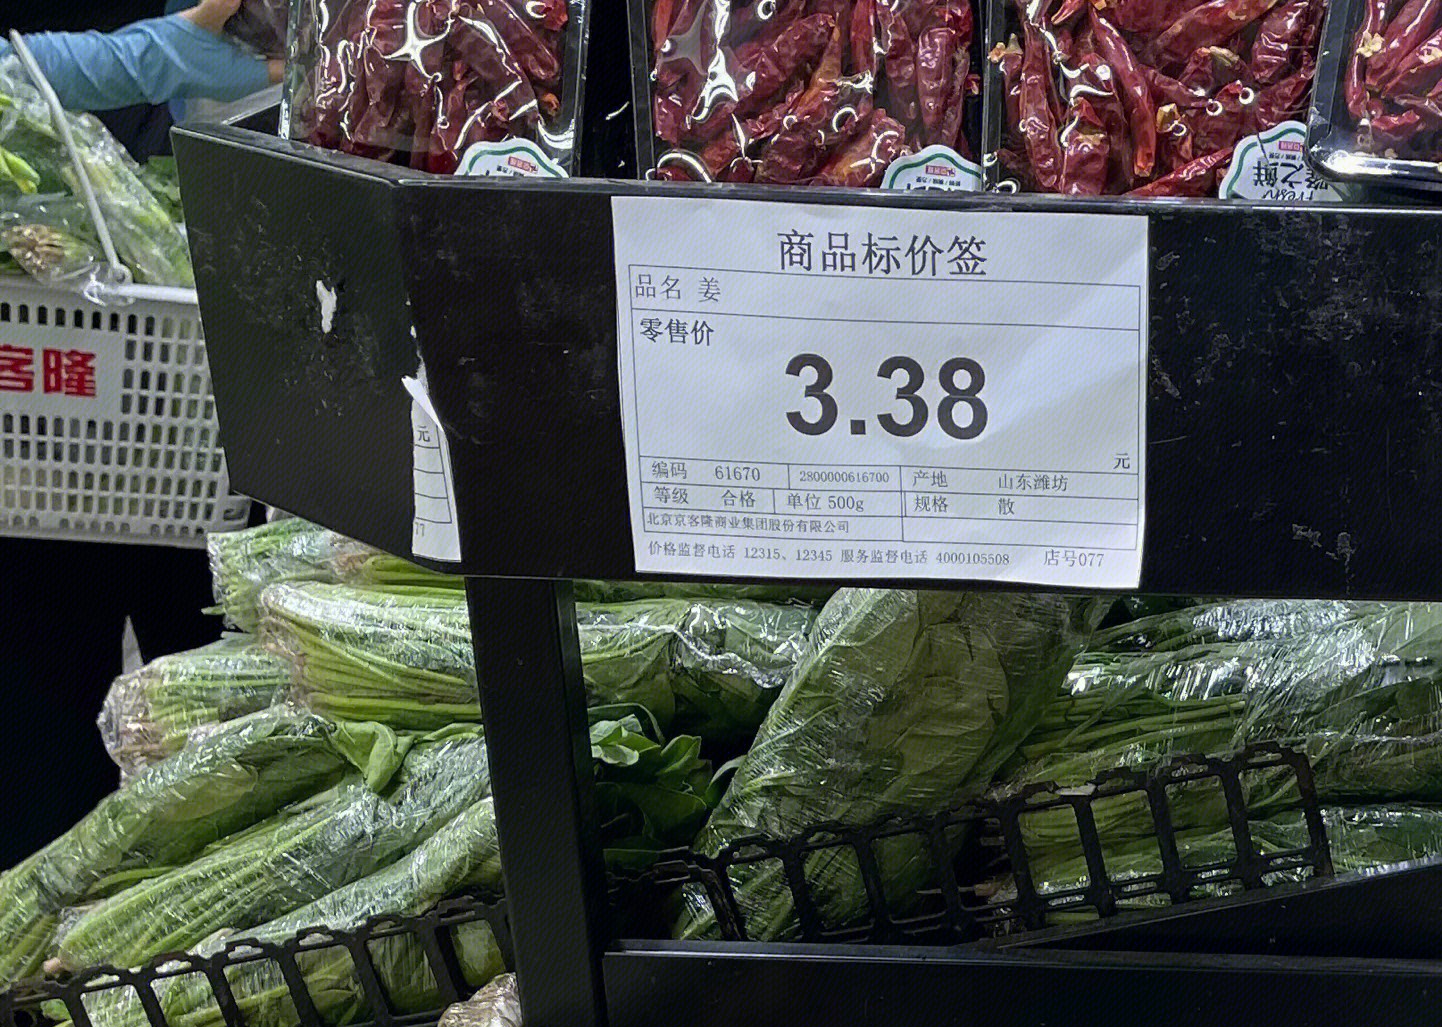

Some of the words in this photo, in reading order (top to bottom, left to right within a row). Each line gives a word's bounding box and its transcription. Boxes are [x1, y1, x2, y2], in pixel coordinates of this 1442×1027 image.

[777, 229, 988, 277] 商品标价签
[634, 273, 682, 300] 品名
[698, 276, 721, 303] 姜
[639, 317, 715, 347] 零售价
[785, 352, 989, 440] 3.38
[416, 425, 430, 442] 元
[651, 459, 688, 481] 编码
[714, 465, 761, 481] 61670
[1113, 452, 1131, 470] 元
[912, 469, 948, 489] 产地
[998, 473, 1068, 492] 山东潍坊
[653, 485, 689, 505] 等级
[721, 490, 756, 508] 合格
[787, 492, 821, 510] 单位
[828, 494, 865, 512] 500g
[914, 496, 948, 514] 规格
[998, 497, 1015, 515] 散
[646, 513, 850, 534] 北京京客隆商业集团股份有限公司
[648, 540, 736, 559] 价格监督电话
[841, 549, 929, 564] 服务监督电话
[935, 552, 1010, 566] 4000105508
[1043, 548, 1104, 569] 店号077
